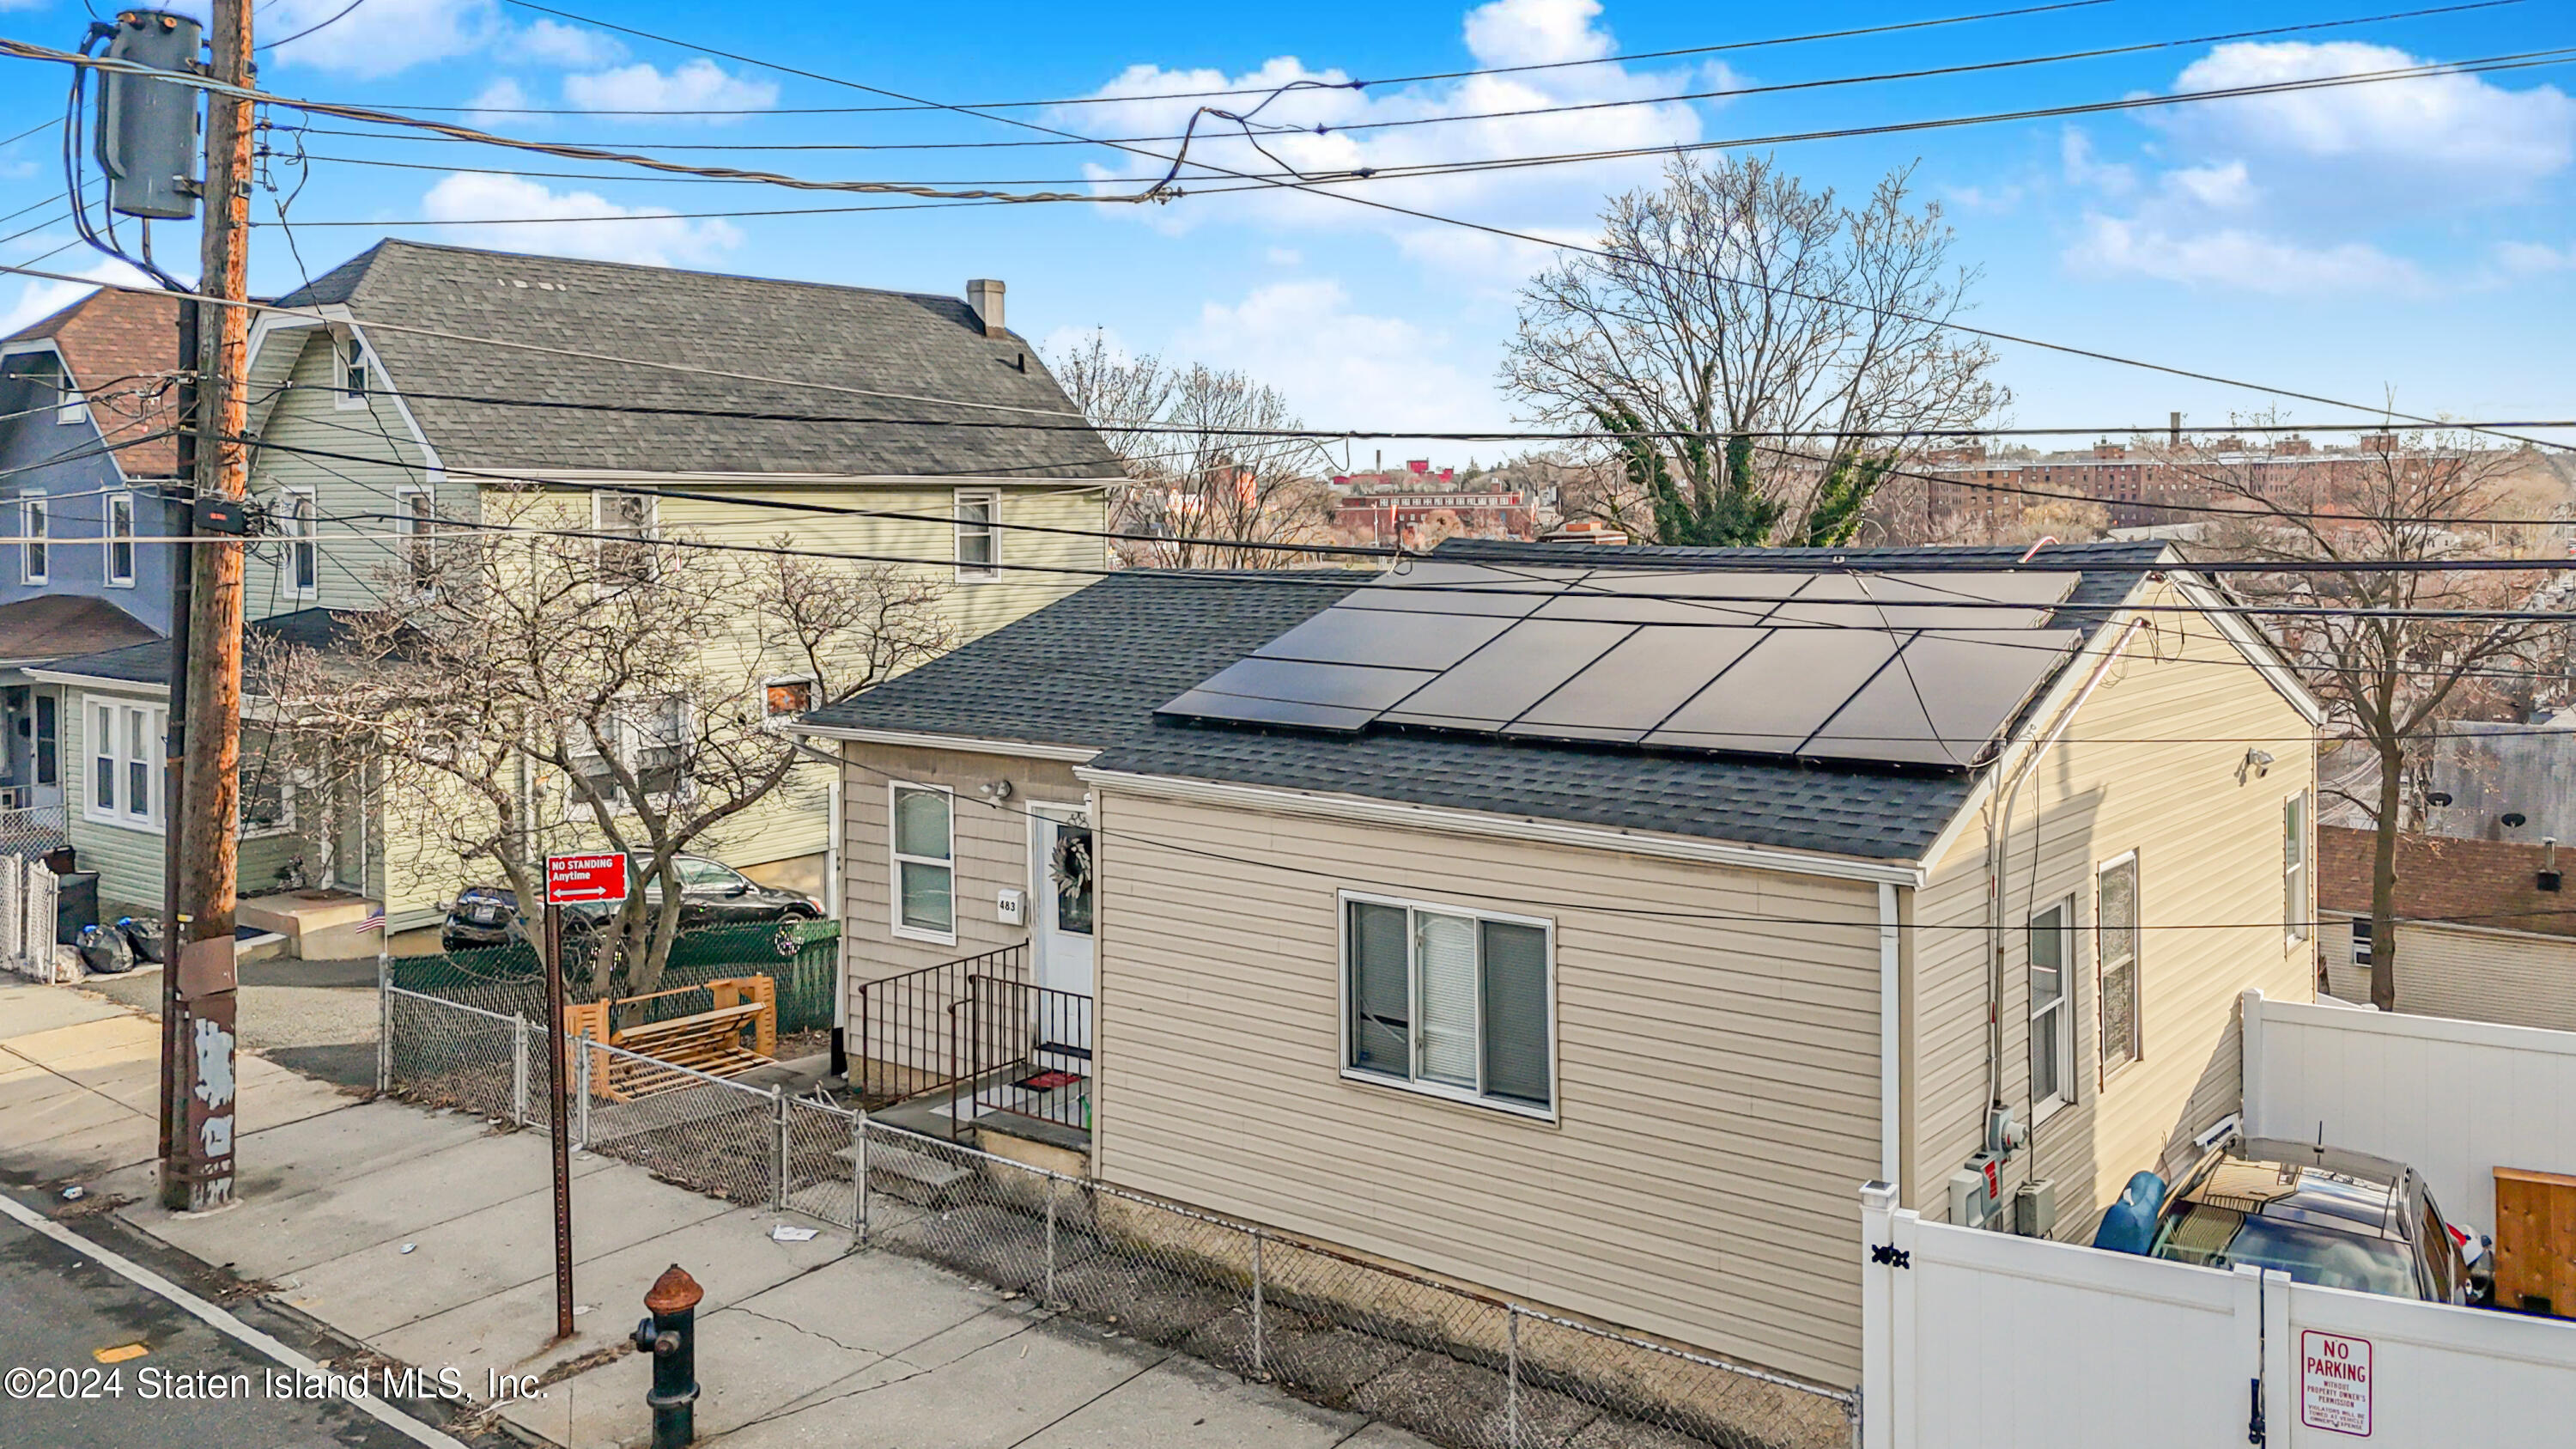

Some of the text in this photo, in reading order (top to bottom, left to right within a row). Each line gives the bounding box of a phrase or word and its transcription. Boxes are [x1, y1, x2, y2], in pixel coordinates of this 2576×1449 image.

[552, 859, 613, 870] NO STANDING
[553, 871, 591, 882] Anytime
[999, 900, 1015, 911] 483
[2324, 1340, 2348, 1360] NO
[2307, 1357, 2366, 1382] PARKING
[2324, 1380, 2349, 1391] WITHOUT
[2307, 1385, 2366, 1402] PROPERTY OWNER'S
[2318, 1395, 2354, 1408] PERMISSION
[2308, 1404, 2340, 1416] VIOLATORS
[2309, 1409, 2328, 1418] TOWED
